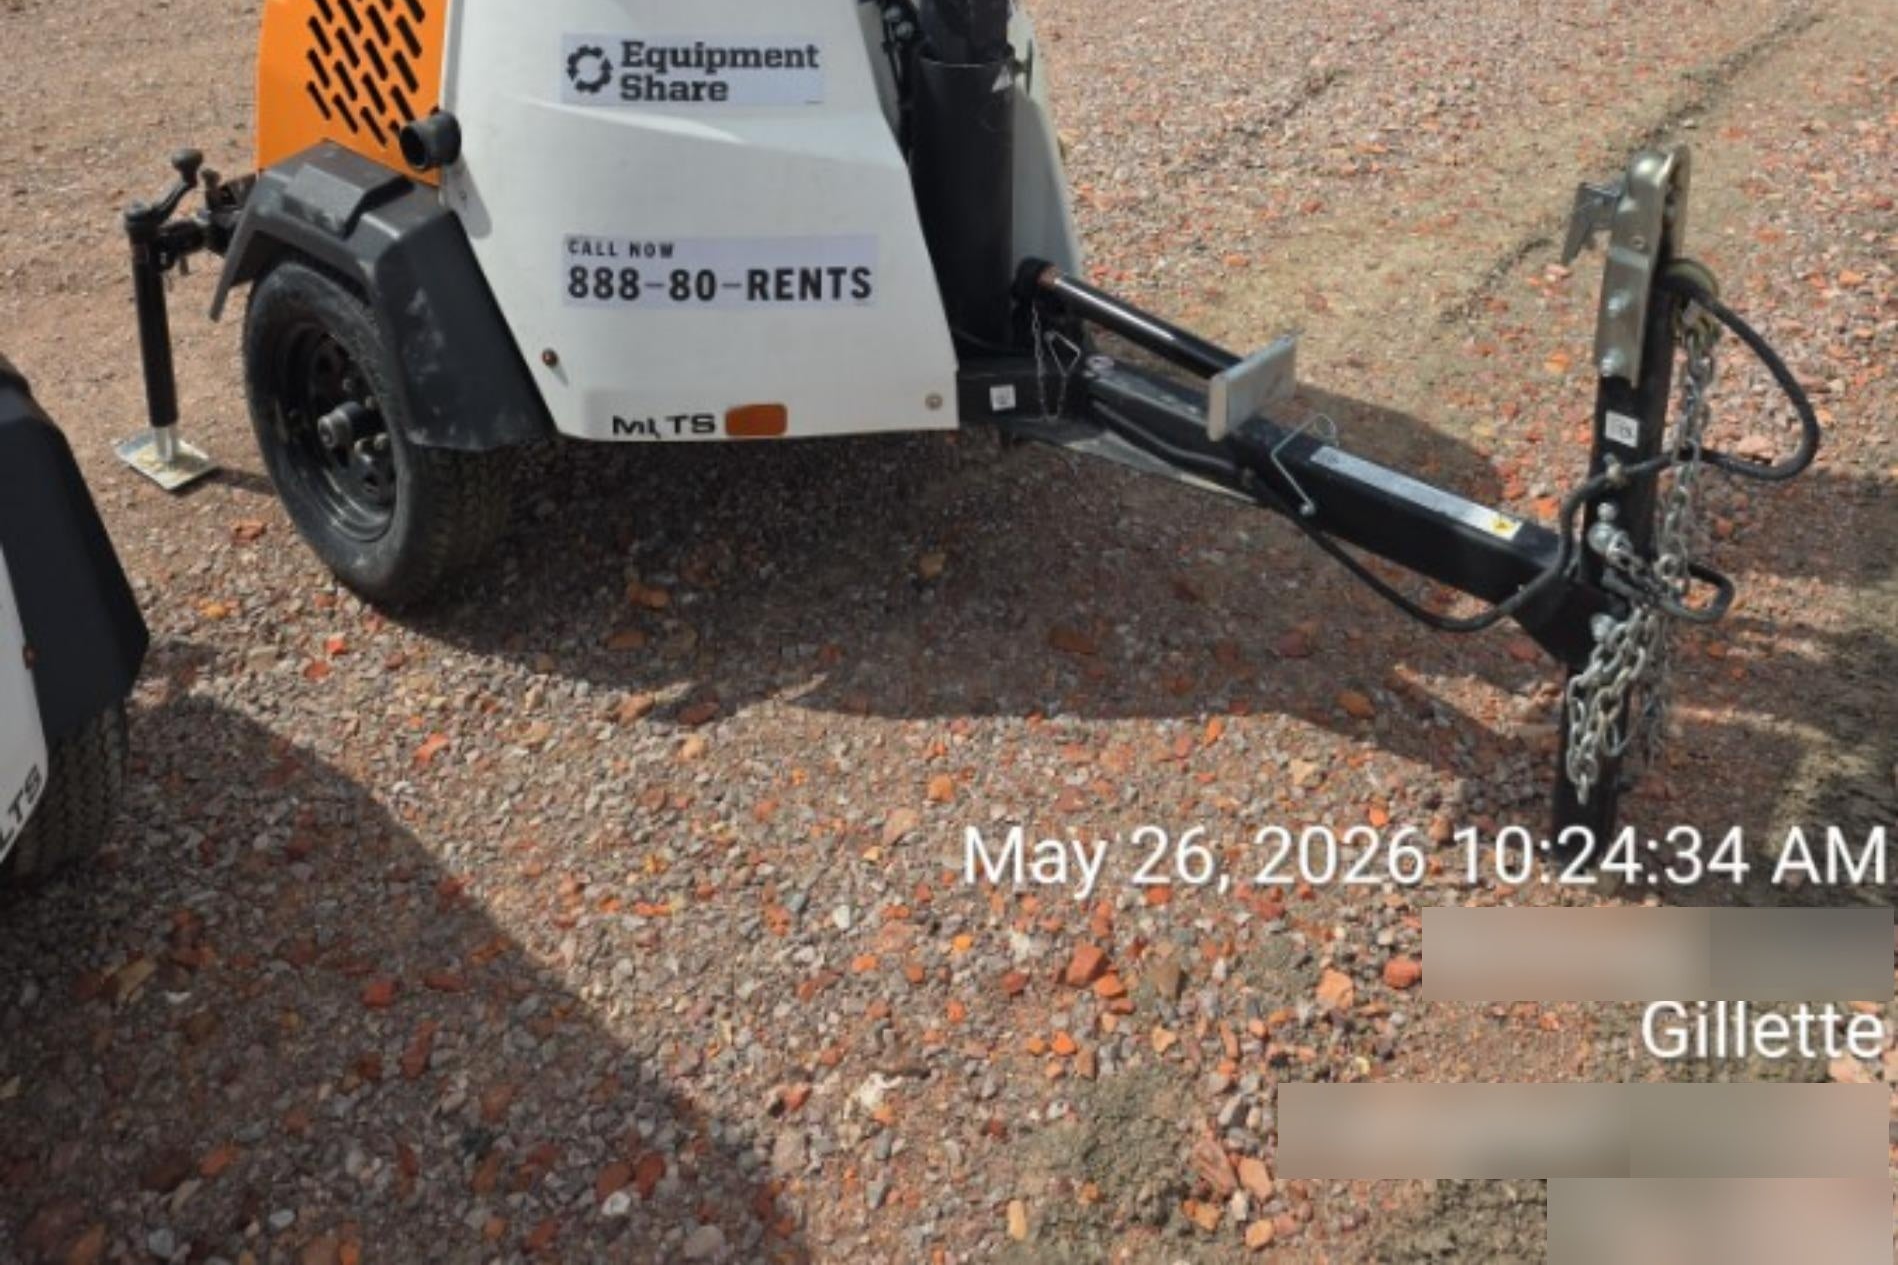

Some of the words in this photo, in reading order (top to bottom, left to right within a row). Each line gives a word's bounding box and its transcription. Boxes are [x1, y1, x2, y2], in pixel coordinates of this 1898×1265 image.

[620, 40, 820, 75] Equipment
[620, 74, 729, 102] Share
[567, 240, 619, 257] CALL
[629, 241, 675, 259] NOW
[567, 265, 873, 301] 888-80-RENTS
